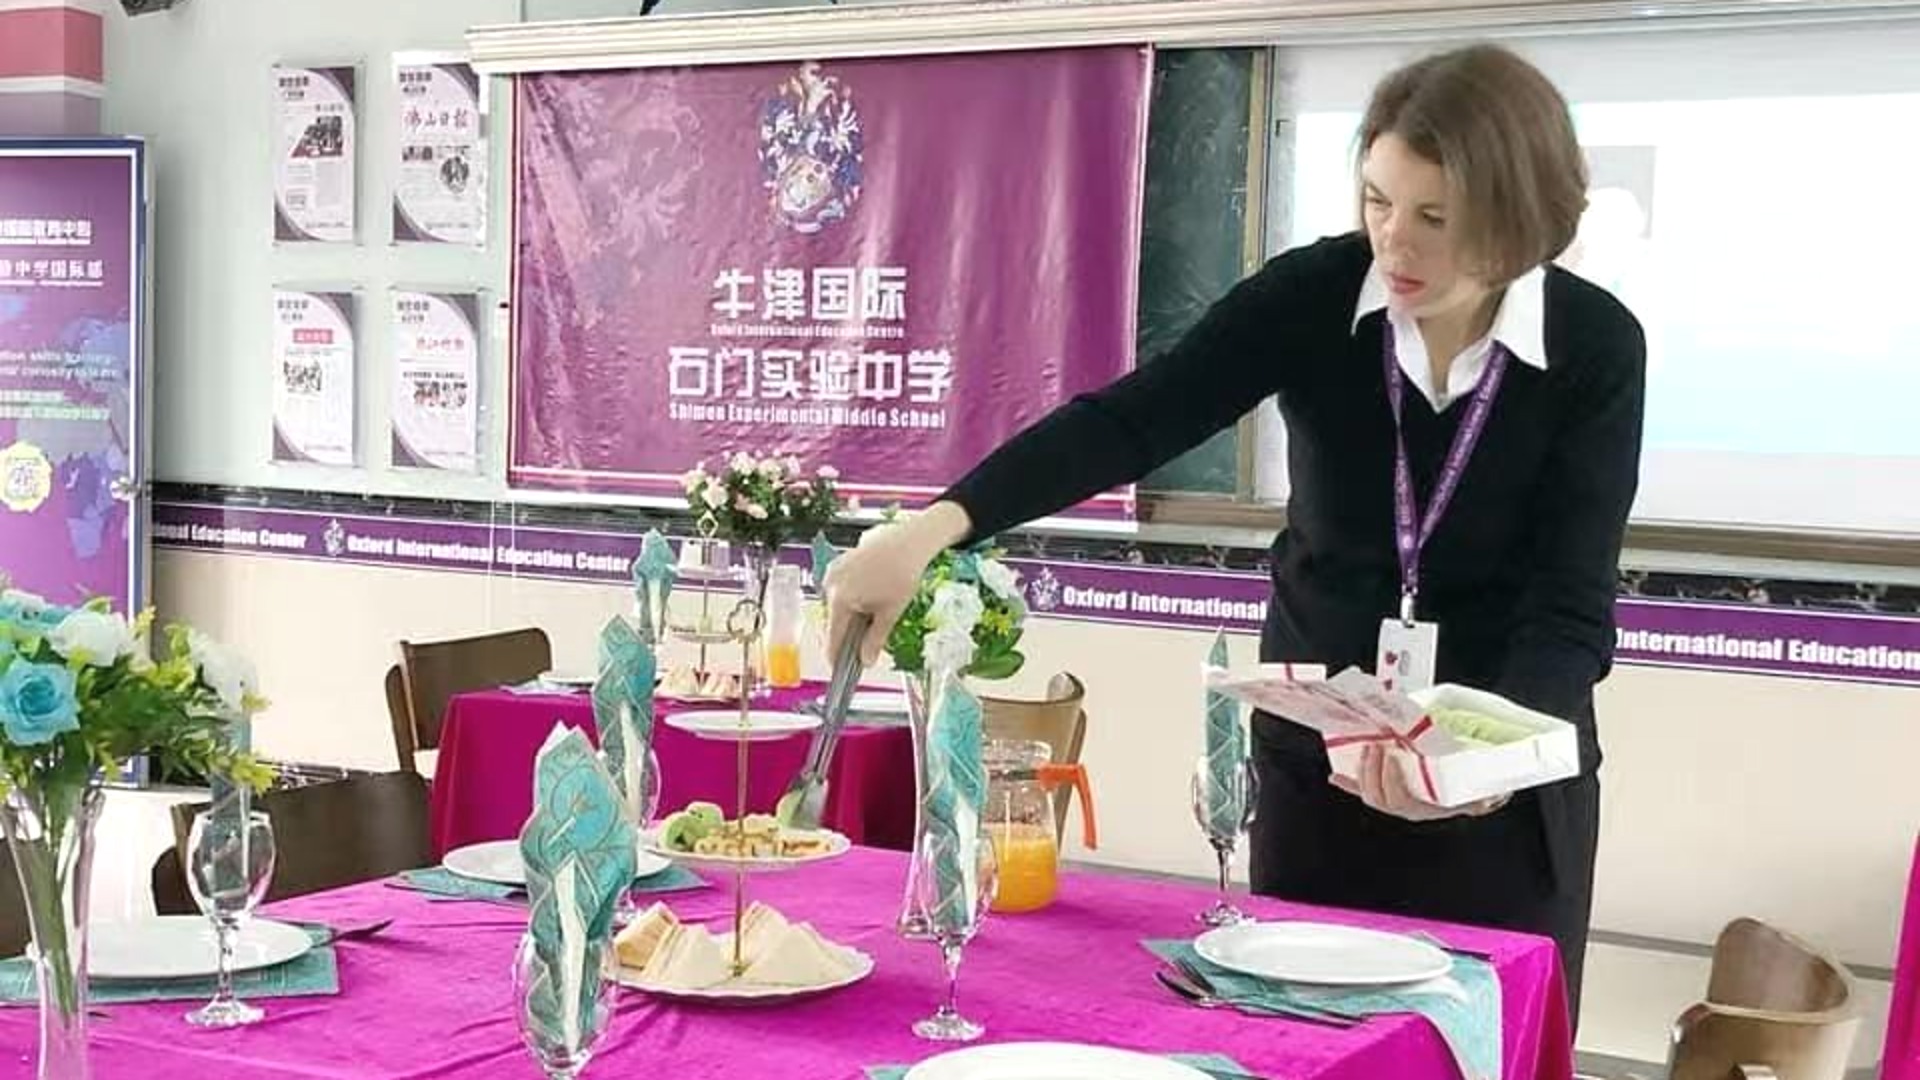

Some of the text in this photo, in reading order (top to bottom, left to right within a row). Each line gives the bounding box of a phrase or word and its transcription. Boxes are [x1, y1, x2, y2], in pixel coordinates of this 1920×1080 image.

[712, 266, 907, 320] 牛津国际
[668, 346, 952, 402] 石门实验中学
[669, 403, 946, 429] Shimen Experimental Middle School
[191, 523, 257, 545] Education
[259, 529, 307, 549] Center
[347, 535, 631, 573] Oxford International Education Center
[1063, 585, 1267, 621] Oxford International
[1615, 627, 1920, 671] International Education
